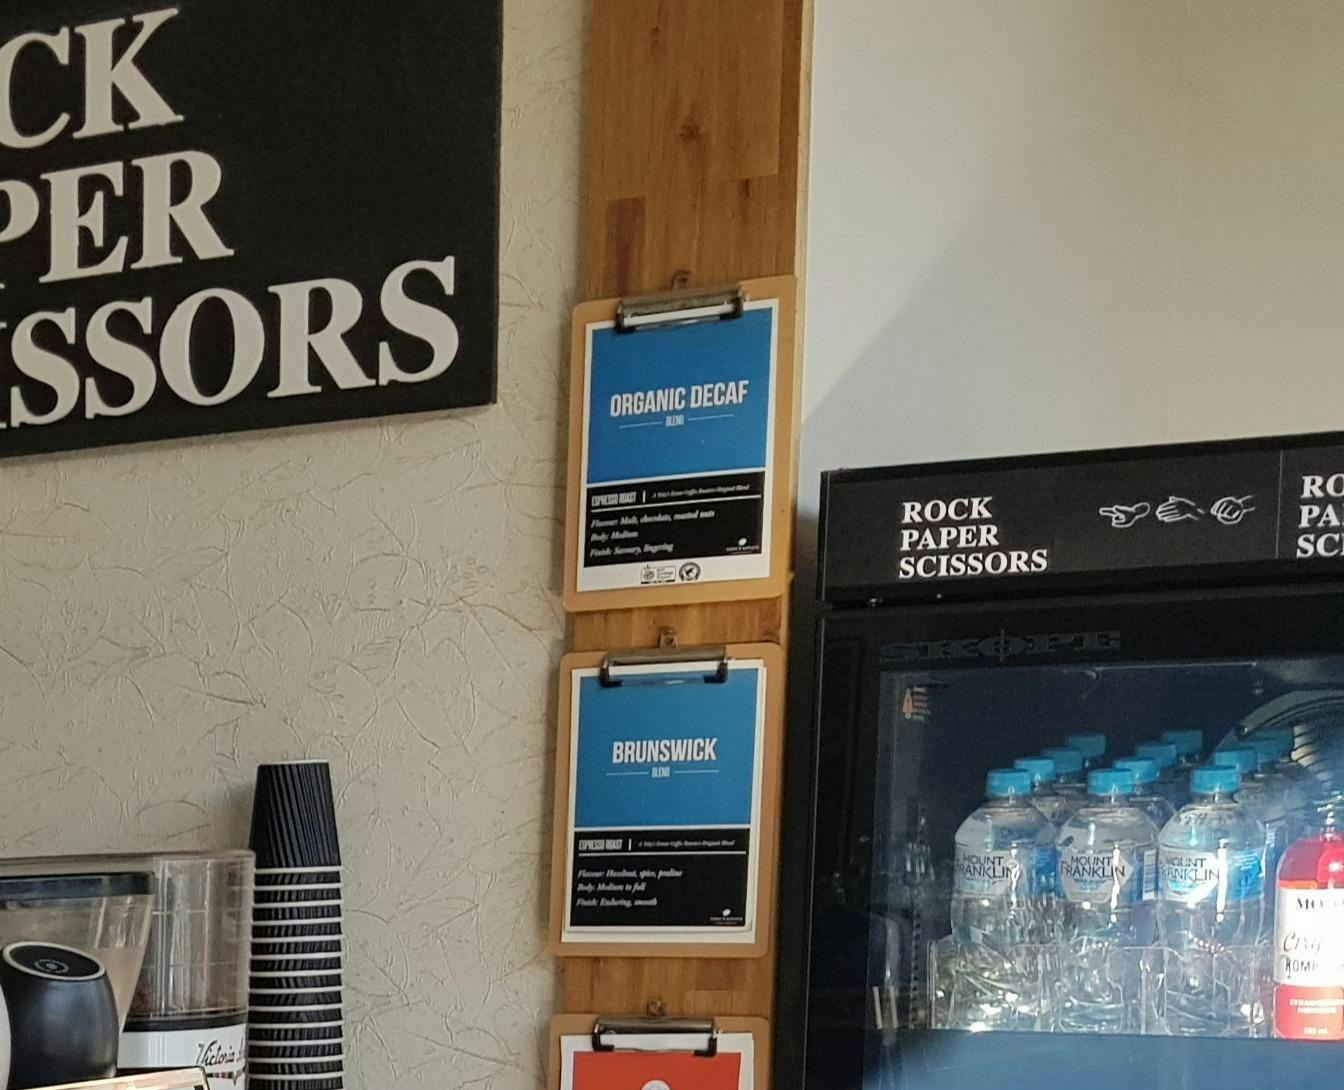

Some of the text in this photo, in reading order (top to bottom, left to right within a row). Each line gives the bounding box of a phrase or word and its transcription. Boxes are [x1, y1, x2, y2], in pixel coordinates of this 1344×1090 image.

[610, 379, 750, 417] ORGANIC DECAF
[665, 414, 685, 427] BLEND
[901, 496, 994, 524] ROCK
[899, 524, 1000, 552] PAPER
[898, 549, 1048, 579] SCISSORS
[612, 738, 717, 764] BRUNSWICK
[651, 766, 670, 778] BLEND
[963, 854, 1005, 867] MOUNT
[1070, 855, 1113, 868] MOUNT
